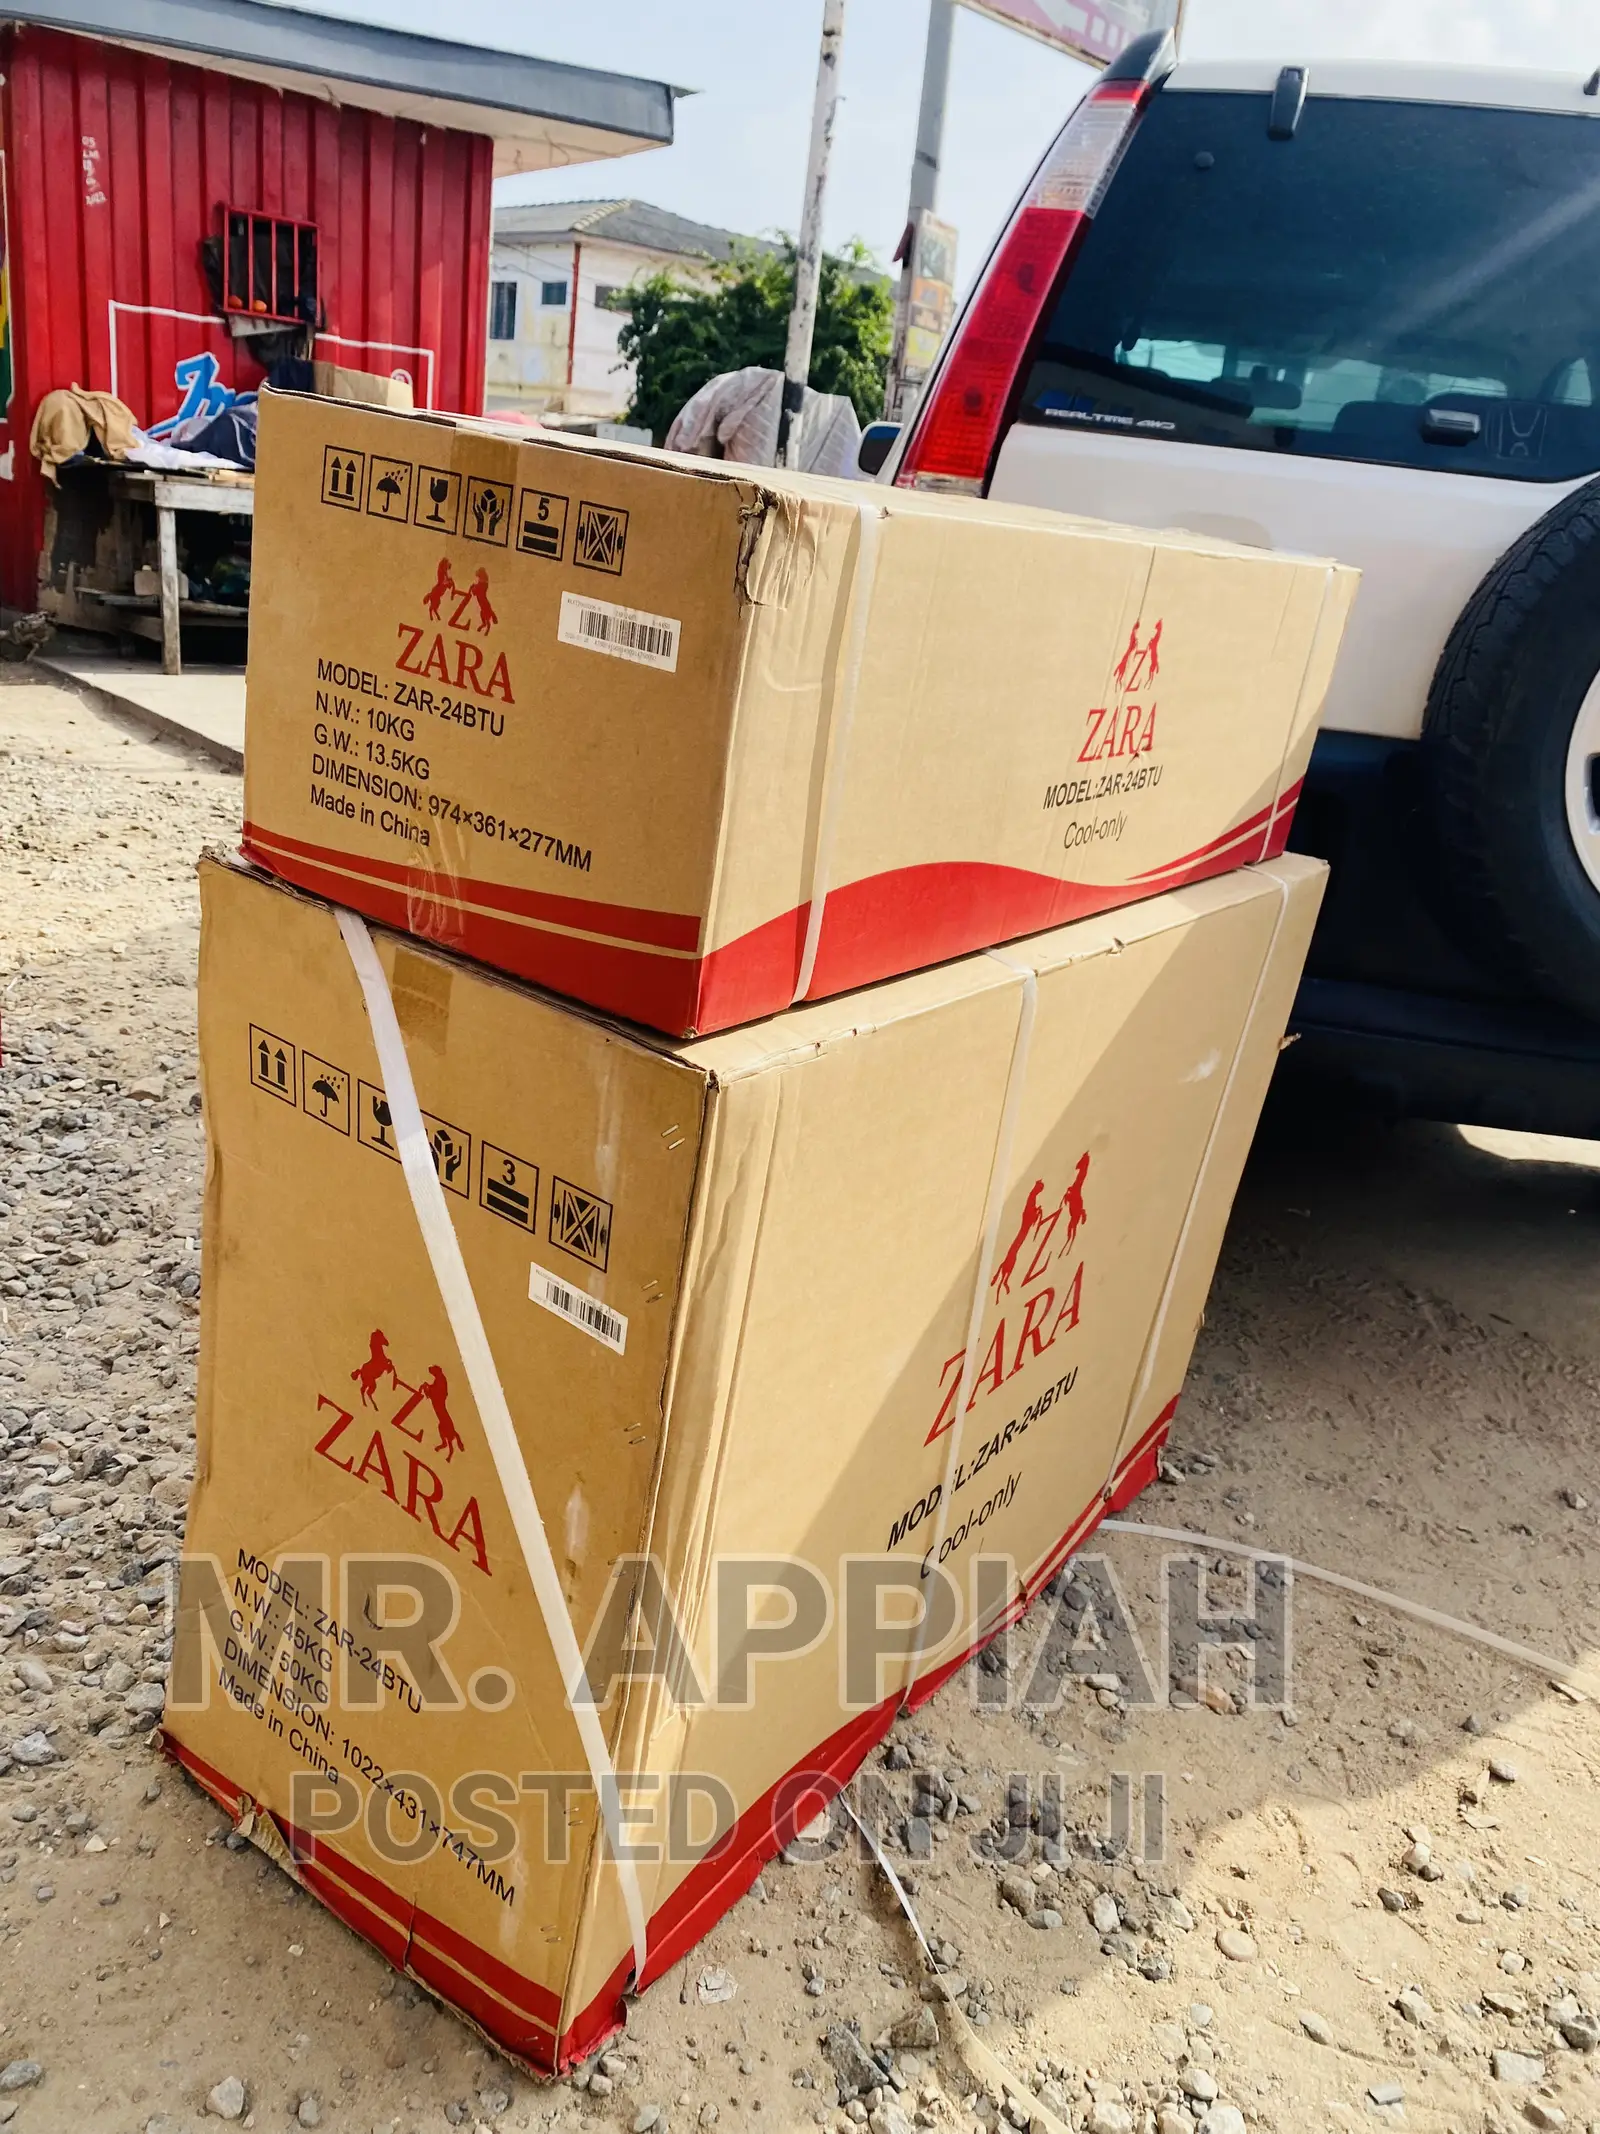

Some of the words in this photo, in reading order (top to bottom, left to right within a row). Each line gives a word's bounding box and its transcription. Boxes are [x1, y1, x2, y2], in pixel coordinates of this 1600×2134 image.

[1136, 419, 1175, 431] 4WD
[537, 498, 550, 521] 5
[318, 658, 389, 701] MODEL:
[394, 683, 505, 737] ZAR-24BTU
[395, 623, 515, 704] ZARA
[314, 724, 359, 757] G.W.:
[366, 742, 431, 780] 13.5KG
[316, 691, 360, 725] N.W.:
[367, 708, 415, 741] 10KG
[1077, 702, 1157, 762] ZARA
[310, 785, 355, 818] Made
[360, 800, 375, 825] in
[381, 811, 431, 847] China
[312, 754, 423, 811] DIMENSION:
[1064, 811, 1128, 849] Cool-only
[502, 1159, 517, 1186] 3
[923, 1261, 1084, 1447] ZARA
[314, 1394, 493, 1577] ZARA
[887, 1366, 1078, 1552] MODL:ZAR-24BTU
[920, 1471, 1022, 1579] Cool-only
[229, 1610, 276, 1661] G.W.:
[279, 1650, 329, 1704] 50KG
[234, 1578, 278, 1628] N.W.:
[281, 1618, 333, 1673] 45KG
[237, 1548, 311, 1617] MODEL:
[313, 1607, 424, 1714] ZAR-24BTU
[218, 1667, 265, 1717] Made
[267, 1707, 284, 1738] in
[289, 1727, 340, 1785] China
[223, 1637, 335, 1746] DIMENSION:
